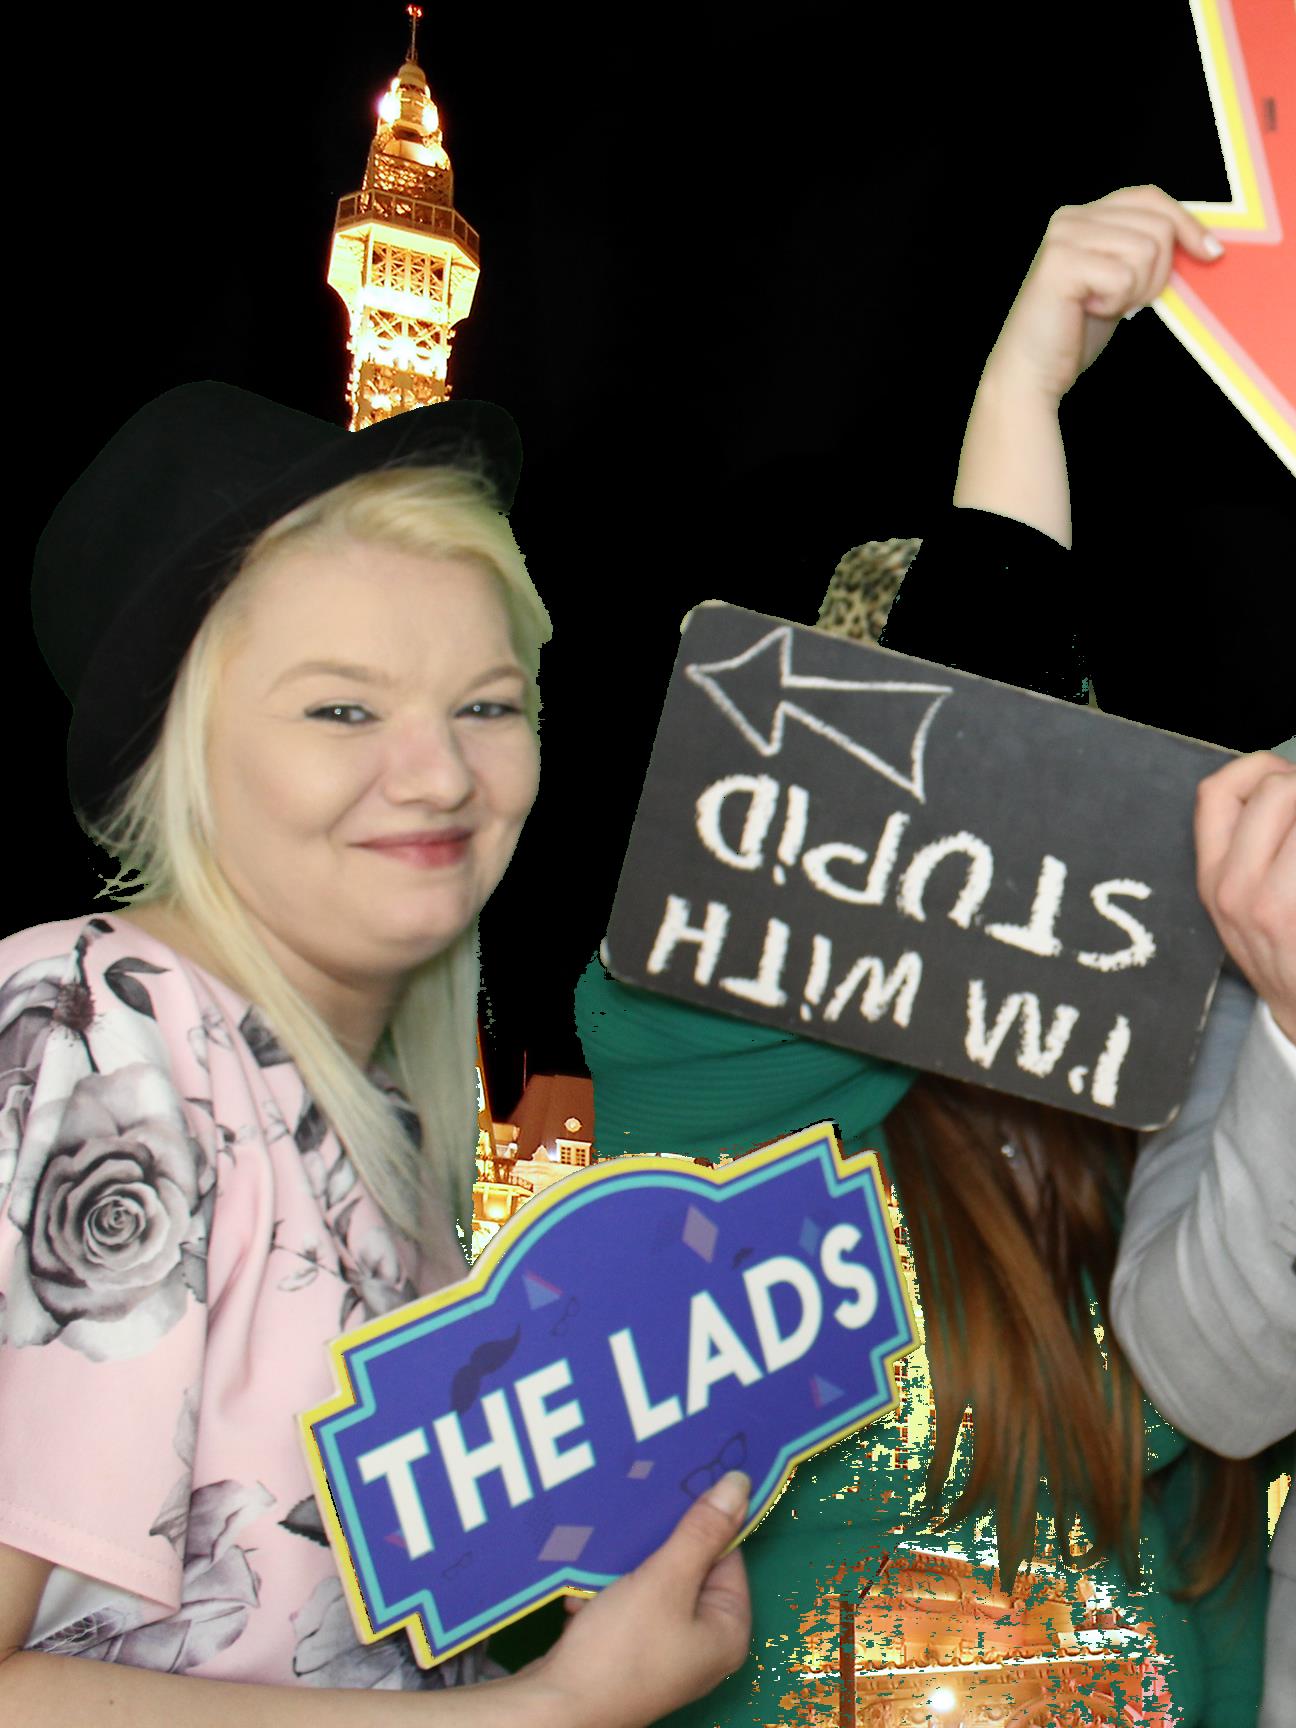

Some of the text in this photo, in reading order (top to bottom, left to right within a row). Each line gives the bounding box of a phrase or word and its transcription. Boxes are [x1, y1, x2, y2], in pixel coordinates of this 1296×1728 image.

[965, 979, 1131, 1107] I'M
[357, 1224, 878, 1561] THE LADS
